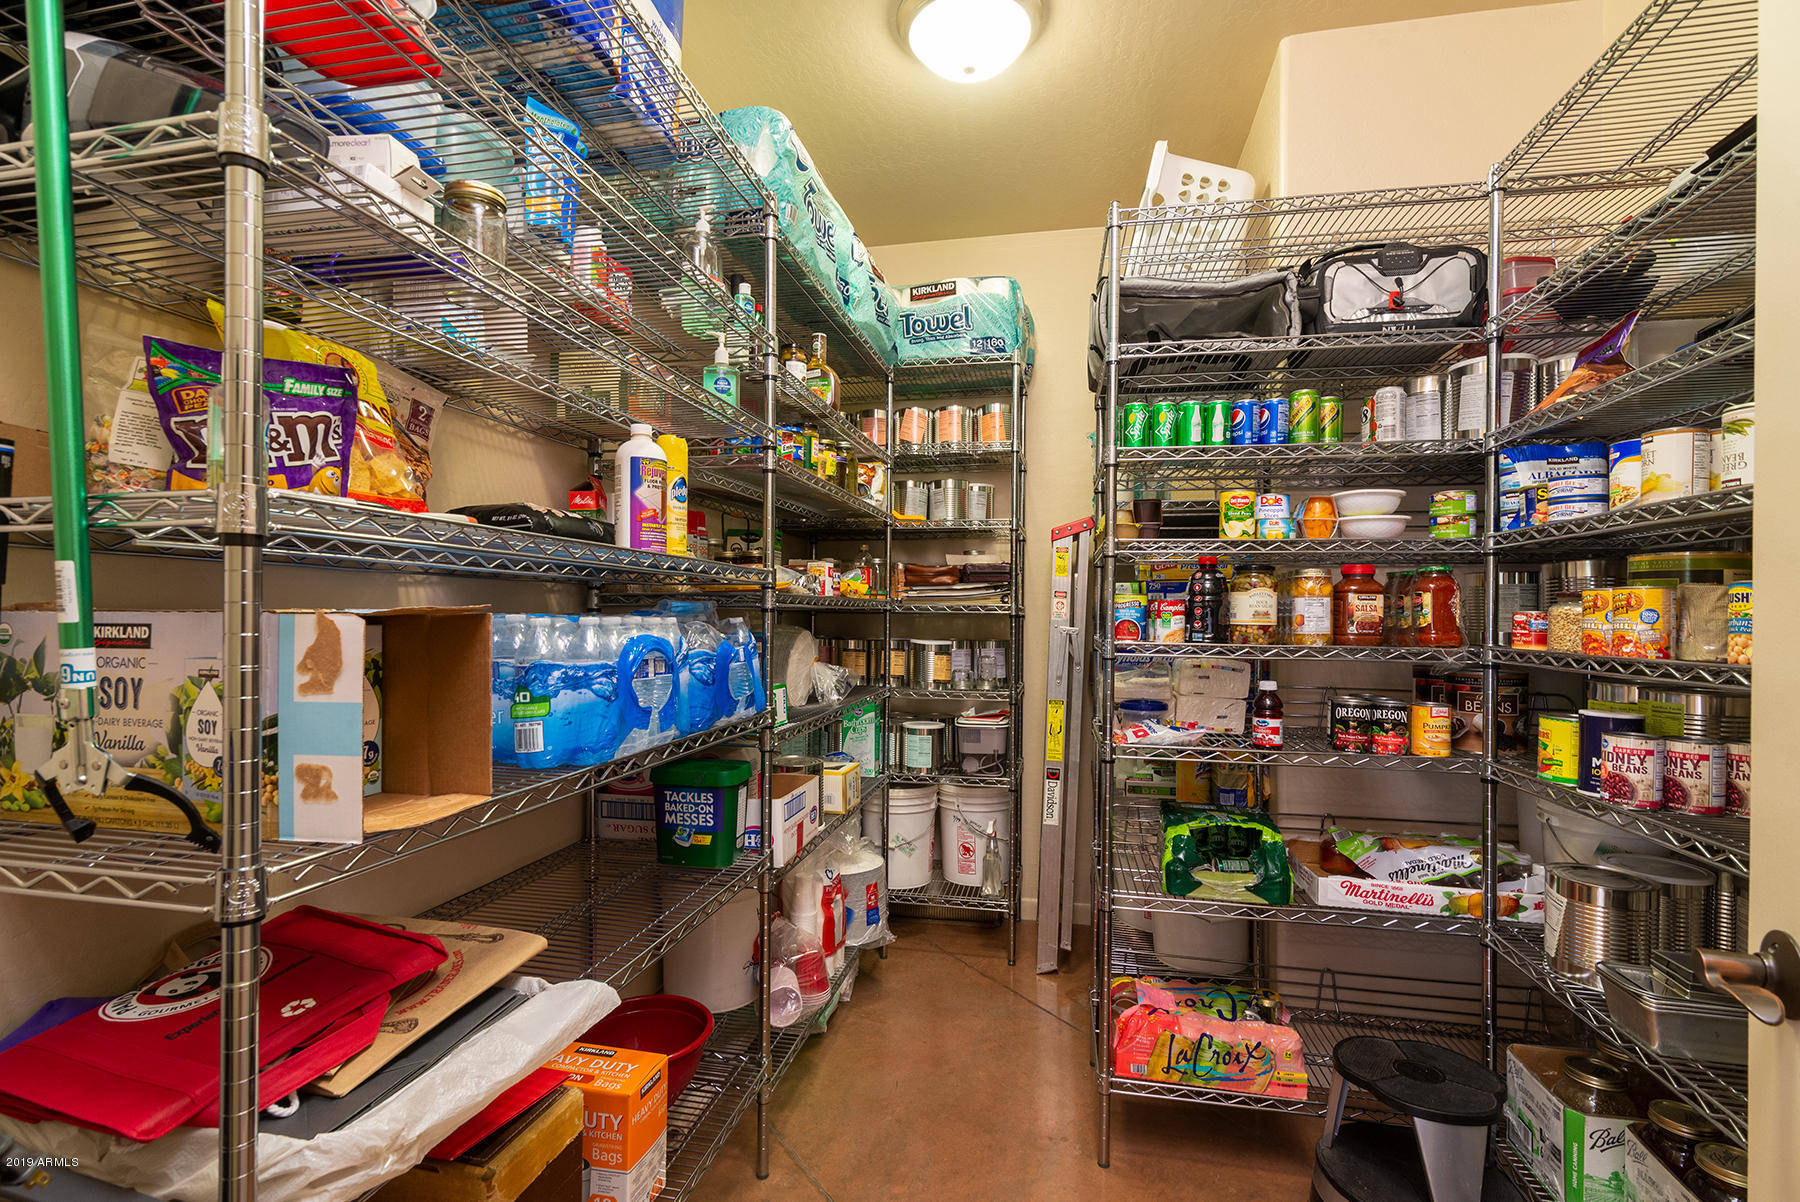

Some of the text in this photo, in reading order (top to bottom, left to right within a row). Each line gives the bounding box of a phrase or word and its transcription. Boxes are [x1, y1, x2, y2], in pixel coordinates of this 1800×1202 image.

[911, 282, 955, 296] KIRKLAND
[898, 303, 974, 338] Towel
[972, 338, 983, 348] 12
[283, 377, 344, 397] FAMILY SIZE
[180, 390, 209, 400] DA
[418, 405, 428, 422] 2
[1361, 408, 1370, 424] 8
[409, 423, 430, 437] BAGS
[1129, 409, 1146, 439] Sprite
[1159, 409, 1176, 439] Sprite
[640, 465, 667, 479] Rejuve
[671, 485, 688, 501] pled
[1260, 495, 1283, 505] Dole
[1728, 592, 1752, 604] USH'
[1160, 602, 1185, 612] Campbel
[1355, 604, 1378, 612] SALSA
[93, 625, 150, 638] KIRKLAND
[96, 656, 147, 669] ORGANIC
[1114, 656, 1150, 664] ynolds
[61, 665, 97, 683] UNG
[99, 675, 144, 710] SOY
[197, 709, 219, 717] ORGANIC
[1464, 700, 1512, 714] BENS
[1335, 706, 1408, 723] OREGON OREGON
[95, 717, 164, 728] -DAIRY BEVERAGE
[197, 719, 217, 735] SOY
[1422, 722, 1451, 730] PUMPK
[94, 729, 145, 752] Vanilla
[195, 744, 219, 754] Vanilla
[1612, 763, 1648, 775] BEANS
[1663, 756, 1701, 771] DNEY
[1727, 760, 1751, 774] NEY
[863, 768, 874, 776] 200
[1666, 768, 1702, 780] BEANS
[1728, 771, 1751, 780] EAN
[664, 790, 714, 804] TACKLES
[1045, 780, 1058, 820] Davidson
[664, 802, 714, 814] BAKED-ON
[664, 812, 714, 826] MESSES
[610, 823, 648, 833] SUGAR
[1427, 852, 1447, 862] GOLD
[1339, 880, 1435, 907] Martinelli's
[1362, 899, 1410, 910] GOLD MEDAL
[164, 1008, 221, 1041] Experien
[578, 1046, 616, 1056] KIRKLAND
[551, 1054, 640, 1073] AVY DUTY
[551, 1063, 594, 1074] COMPACTOR
[600, 1070, 632, 1079] KITCHEN
[593, 1079, 622, 1090] Bags
[641, 1071, 661, 1095] KIRKLAND
[631, 1099, 653, 1126] HEAVY
[653, 1083, 667, 1106] DUTY
[584, 1110, 623, 1131] UTY
[589, 1131, 623, 1141] KITCHEN
[1588, 1127, 1626, 1153] Bal
[591, 1148, 623, 1165] Bags
[1626, 1137, 1648, 1163] Ball
